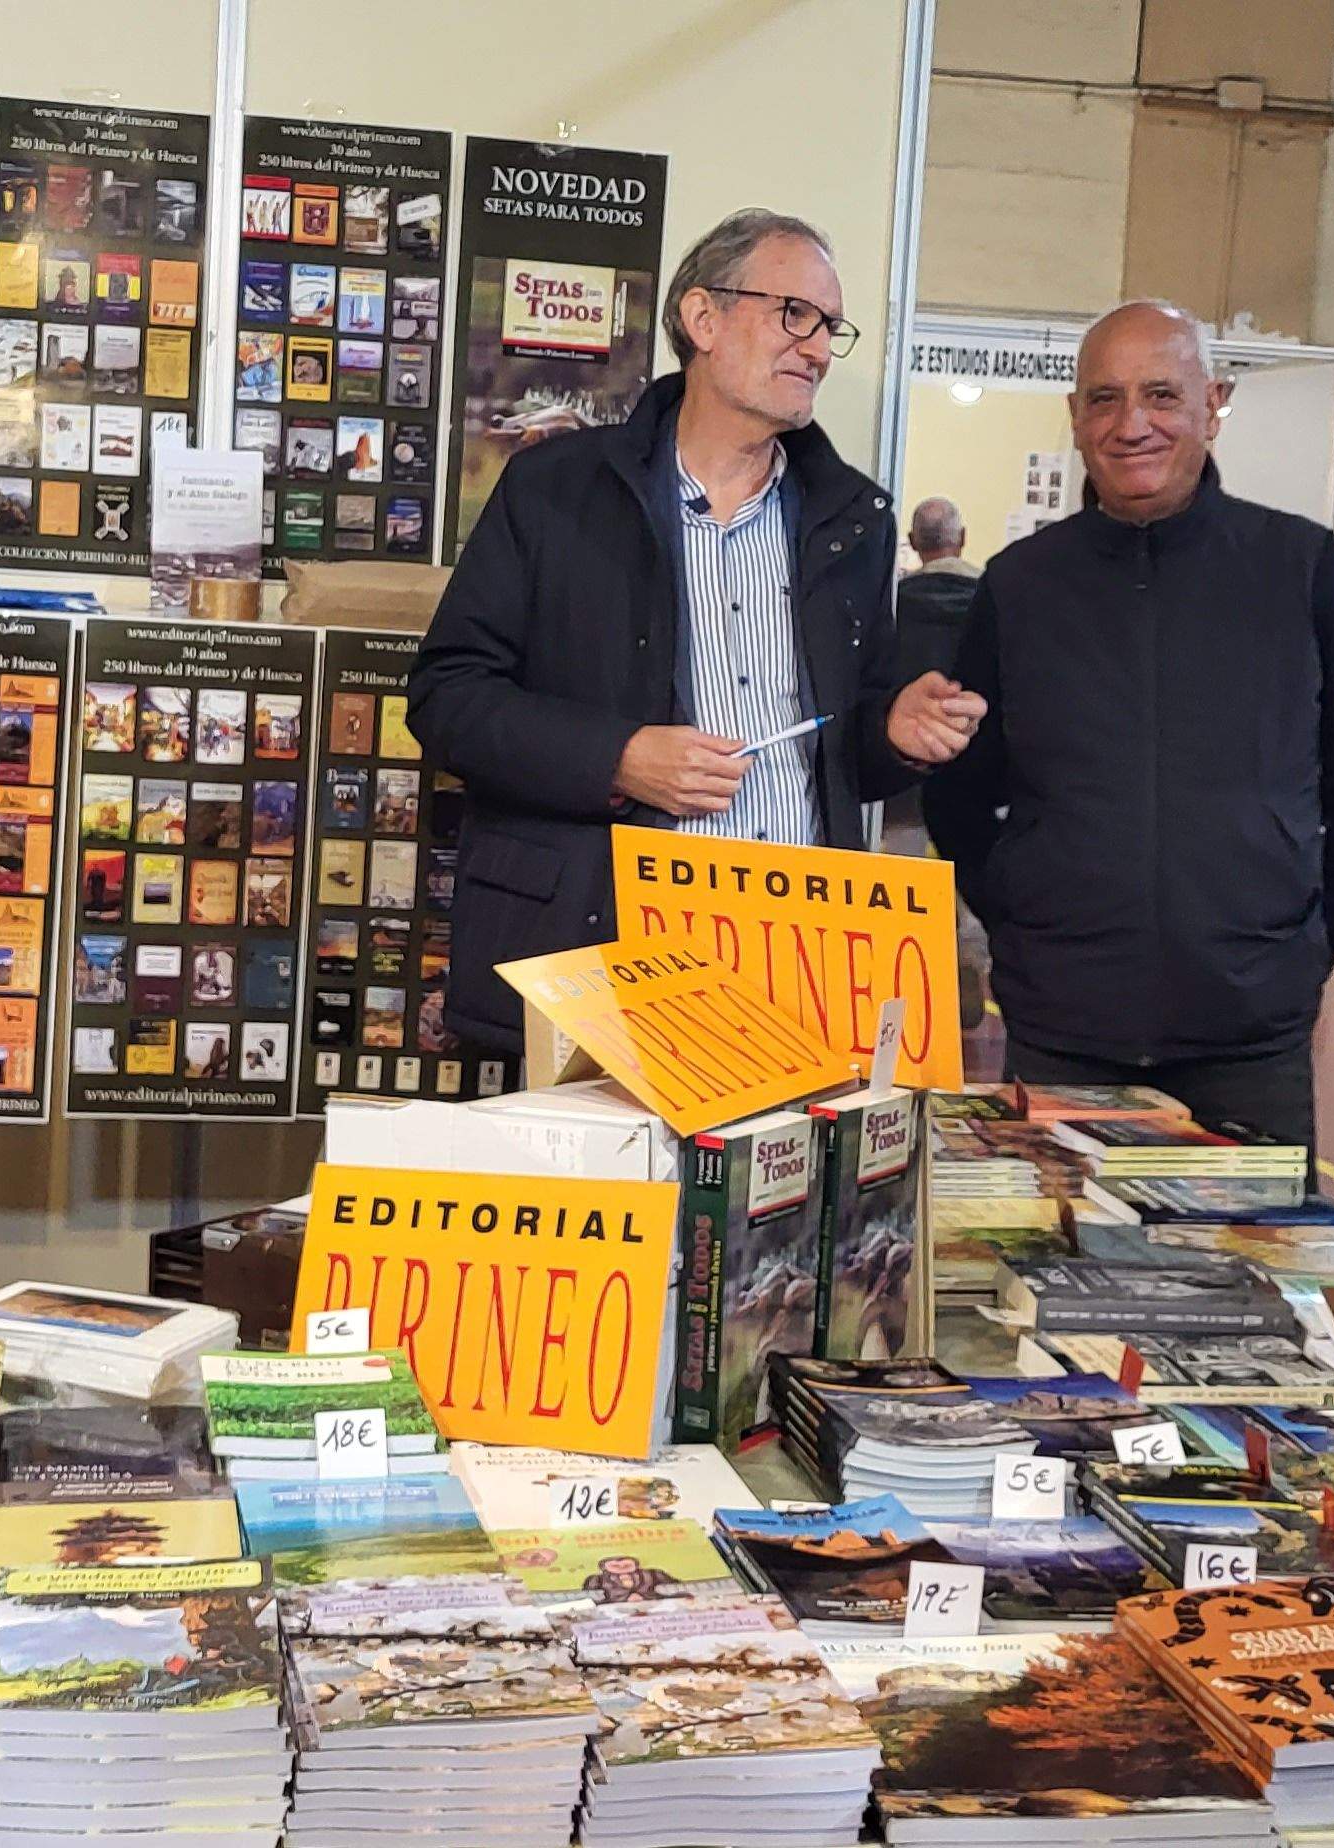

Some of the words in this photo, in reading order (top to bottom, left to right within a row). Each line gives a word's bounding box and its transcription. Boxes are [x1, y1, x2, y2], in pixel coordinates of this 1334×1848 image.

[84, 126, 99, 139] 30
[101, 129, 128, 143] años
[10, 135, 32, 151] 250
[35, 138, 65, 154] libros
[67, 141, 86, 156] del
[88, 143, 128, 160] Pirineo
[141, 147, 155, 161] de
[157, 149, 199, 165] Huesca
[328, 144, 345, 157] 30
[347, 147, 372, 160] años
[258, 153, 280, 168] 250
[282, 155, 313, 171] libros
[315, 157, 331, 172] del
[333, 159, 372, 176] Pirineo
[384, 163, 399, 178] de
[400, 163, 441, 181] Huesca
[490, 165, 647, 205] NOVEDAD
[483, 197, 535, 217] SETAS
[537, 201, 580, 222] PARA
[583, 206, 644, 227] TODOS
[513, 272, 584, 299] SETAS
[526, 296, 604, 323] TODOS
[928, 346, 989, 377] ESTUDIOS
[992, 349, 1075, 382] ARAGONESES
[127, 624, 282, 649] www.editorialpirineo.com
[11, 656, 58, 672] Huesca
[181, 646, 196, 660] 30
[198, 648, 228, 662] años
[103, 660, 126, 675] 250
[128, 660, 163, 677] libros
[165, 662, 183, 678] del
[185, 663, 228, 681] Pirineo
[241, 666, 257, 682] de
[259, 667, 303, 684] Huesca
[339, 670, 362, 685] 250
[637, 854, 929, 914] EDITORIAL
[533, 948, 711, 1006] EDITORIAL
[84, 1085, 277, 1110] www.editorialpirineo.com
[866, 1105, 900, 1132] SETAS
[757, 1137, 796, 1164] SETAS
[869, 1127, 907, 1155] TODOS
[762, 1155, 805, 1184] TODOS
[333, 1194, 645, 1244] EDITORIAL
[687, 1214, 713, 1298] TODOS
[315, 1319, 355, 1341] 5€
[322, 1417, 378, 1453] 18€
[1123, 1434, 1177, 1463] 5€
[1006, 1461, 1058, 1493] 5€
[560, 1482, 615, 1521] 12€
[130, 1570, 164, 1582] del
[171, 1566, 250, 1579] Pirineo
[1197, 1550, 1251, 1585] 16€
